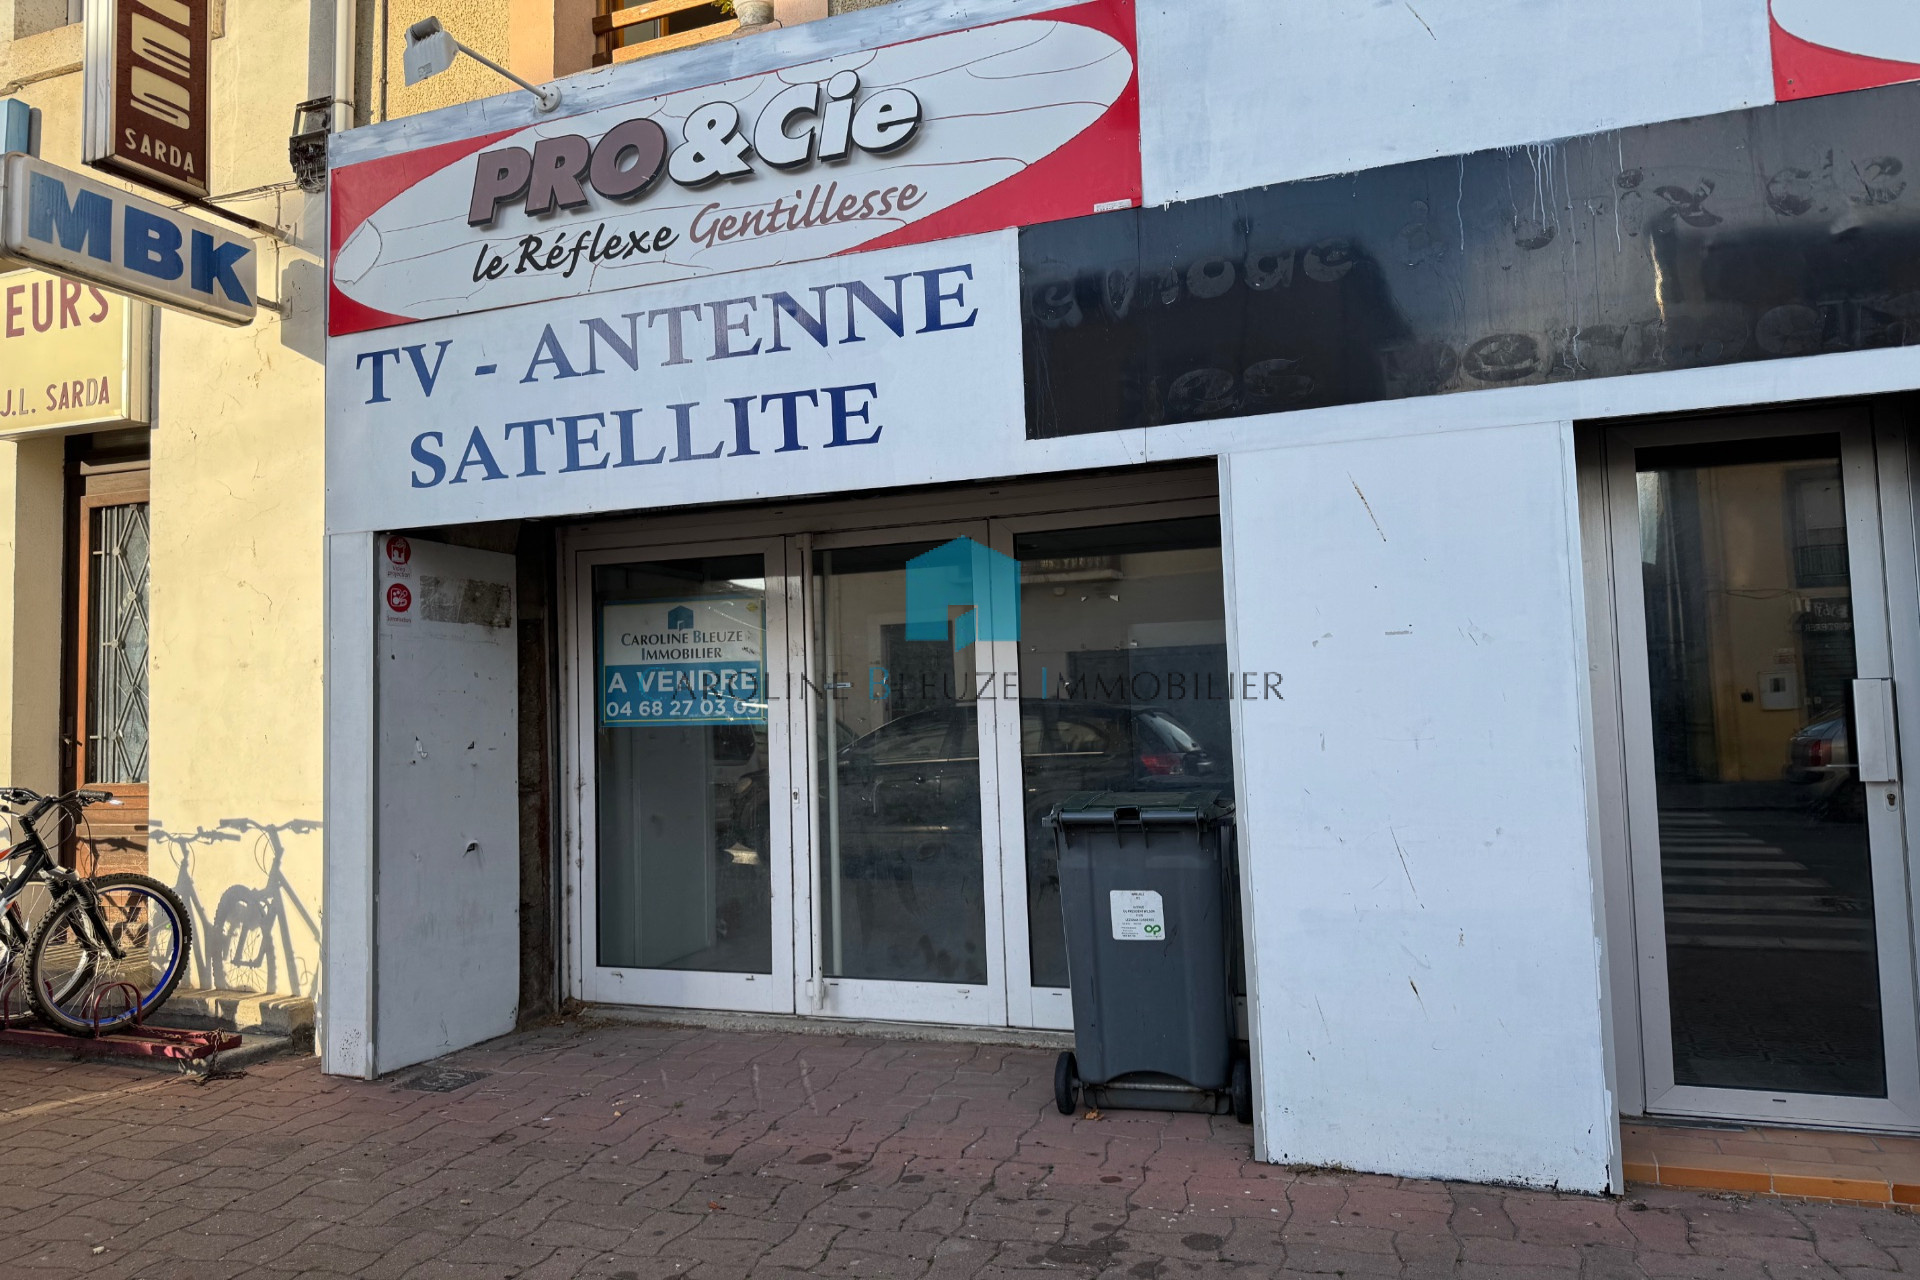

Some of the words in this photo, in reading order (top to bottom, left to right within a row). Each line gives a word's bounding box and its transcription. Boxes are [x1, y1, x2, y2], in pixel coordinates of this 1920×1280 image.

[124, 127, 195, 174] SARDA
[28, 171, 253, 307] MBK
[473, 243, 509, 284] le
[515, 222, 679, 279] Réflexe
[690, 181, 928, 249] Gentillesse
[356, 339, 453, 405] TV
[519, 264, 979, 385] ANTENNE
[46, 376, 110, 412] SARDA
[411, 382, 883, 489] SATELLITE
[621, 632, 689, 646] CAROLINE
[693, 630, 743, 644] BLEUZE
[641, 647, 722, 661] IMMOBILIER
[607, 672, 628, 694] A
[637, 668, 758, 693] VENDRE
[606, 701, 632, 717] 04
[639, 701, 663, 716] 68
[669, 701, 693, 716] 27
[700, 700, 726, 715] 03
